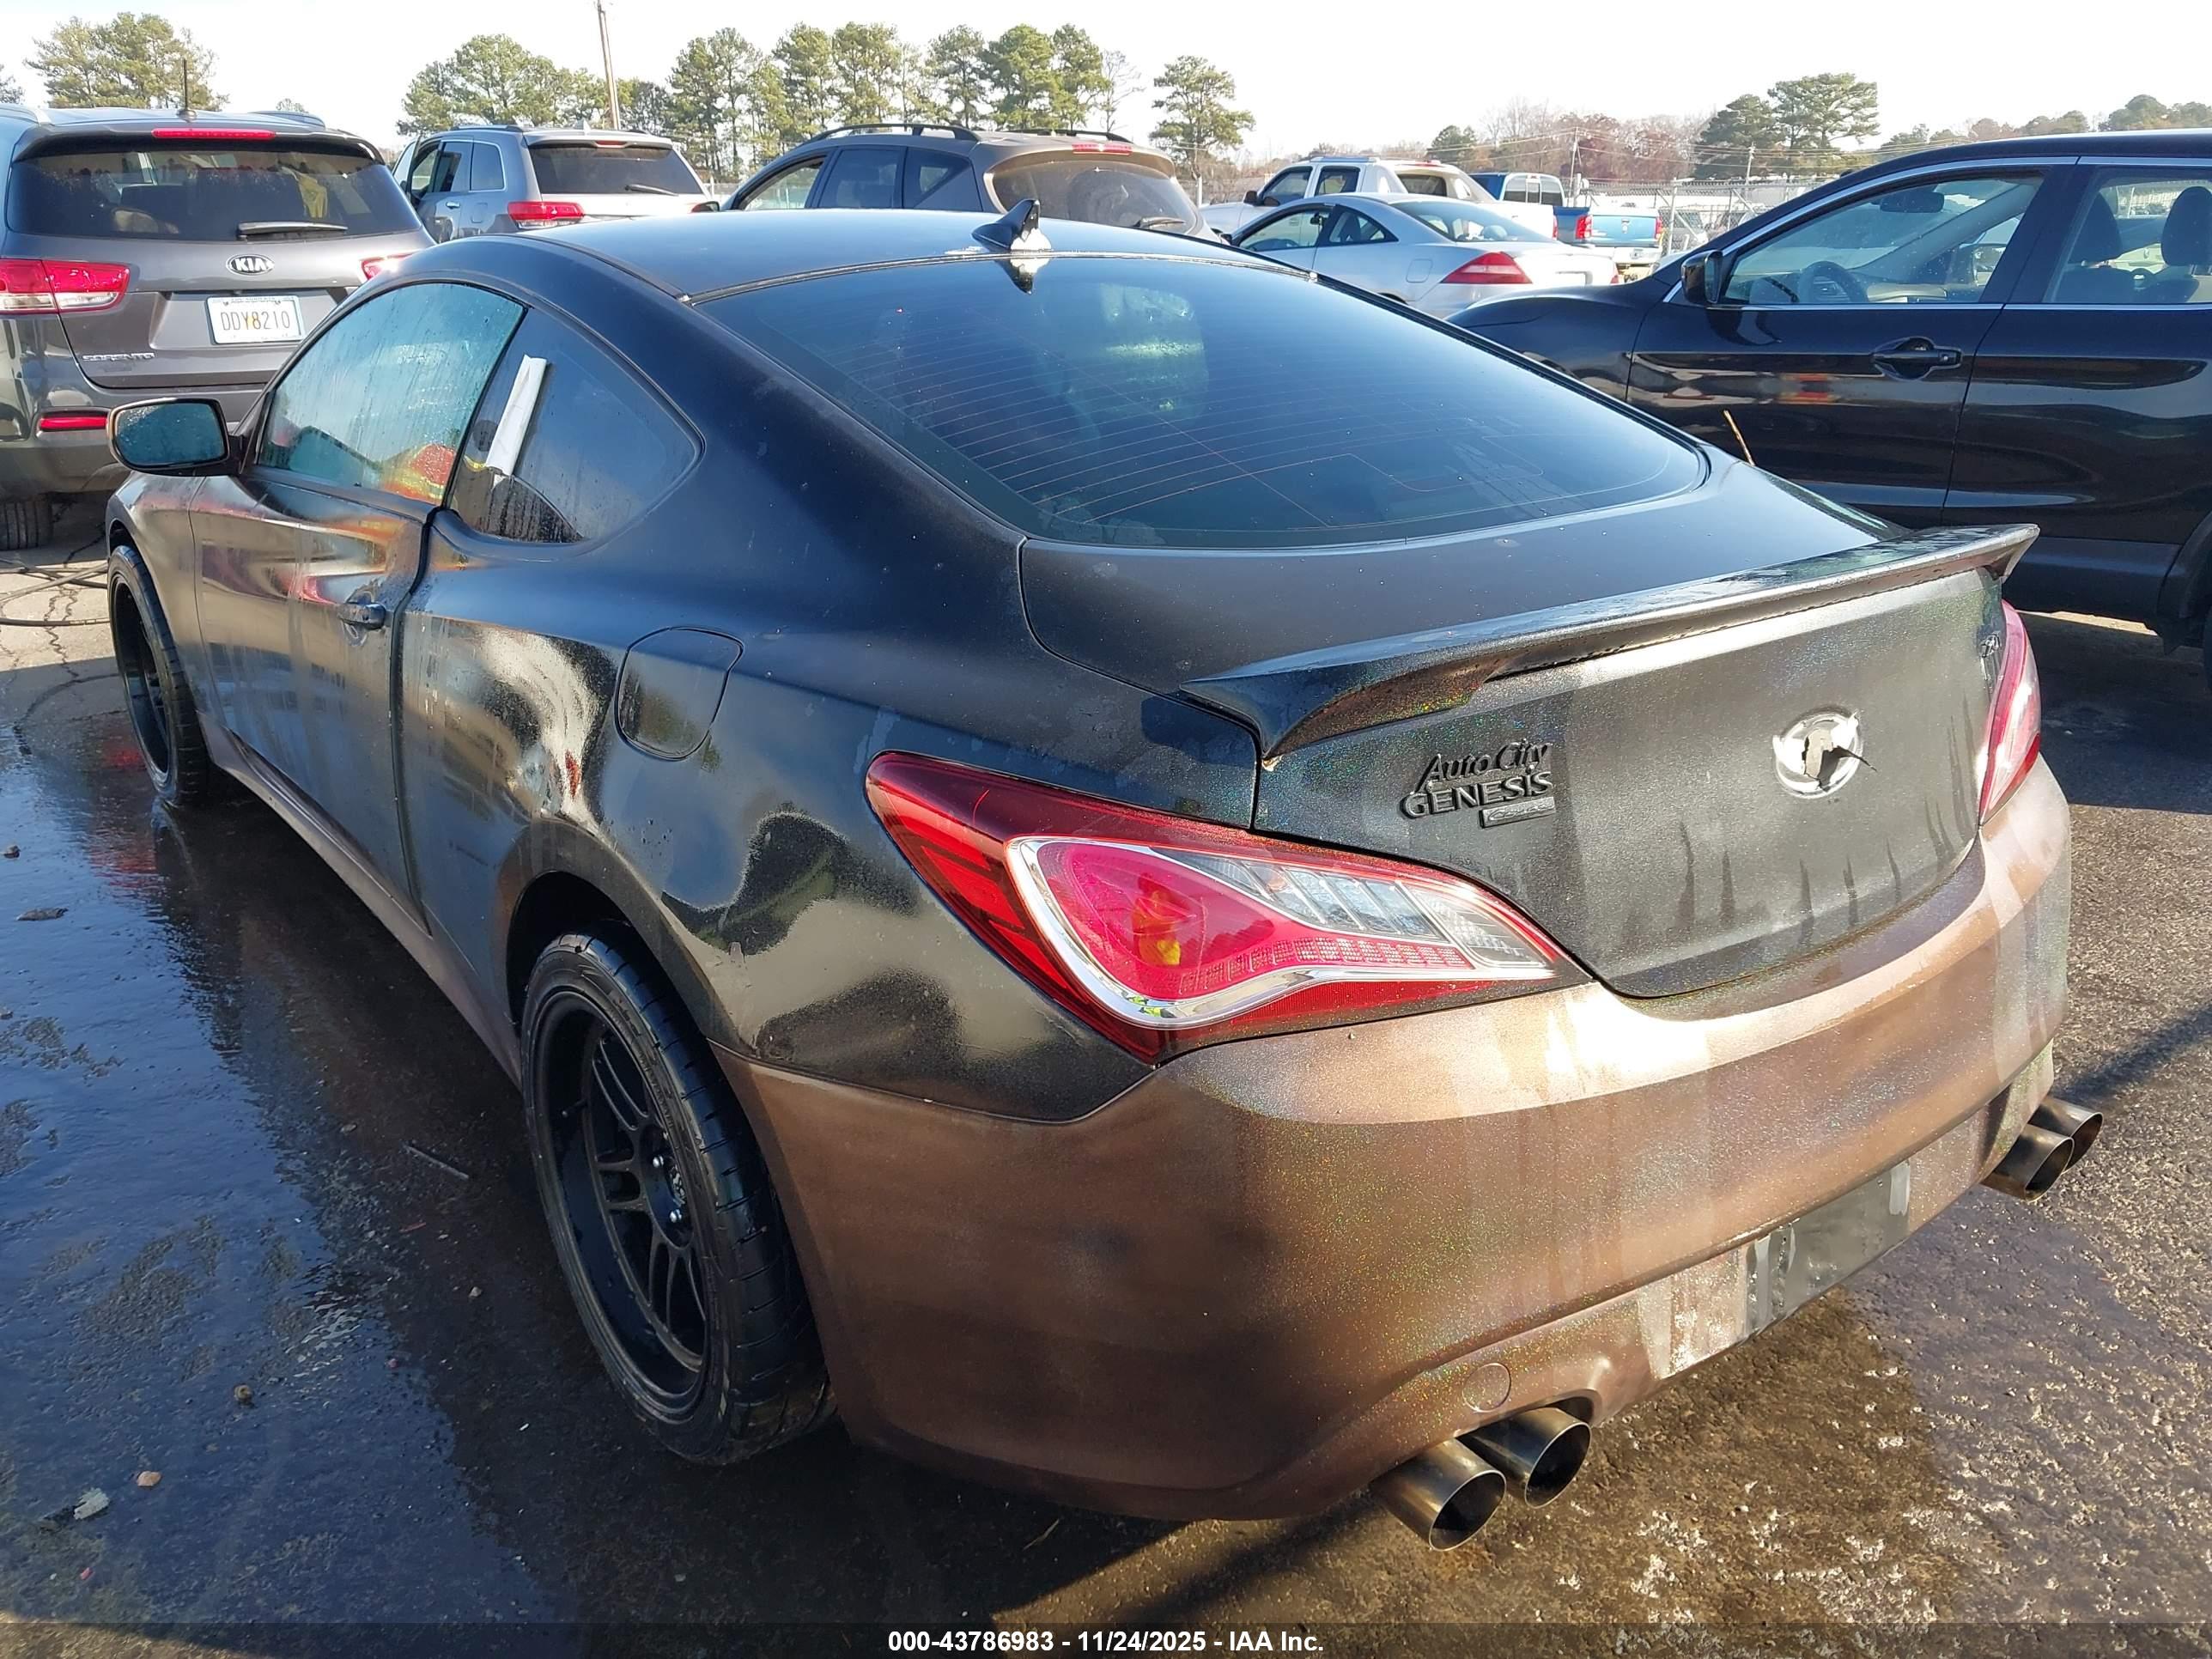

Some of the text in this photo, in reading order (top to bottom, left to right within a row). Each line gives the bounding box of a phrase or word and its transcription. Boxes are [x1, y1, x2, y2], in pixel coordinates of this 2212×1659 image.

[234, 258, 267, 271] KIA
[221, 311, 290, 331] DDY8210
[1410, 738, 1553, 794] Auto City
[1400, 770, 1553, 819] GENESIS
